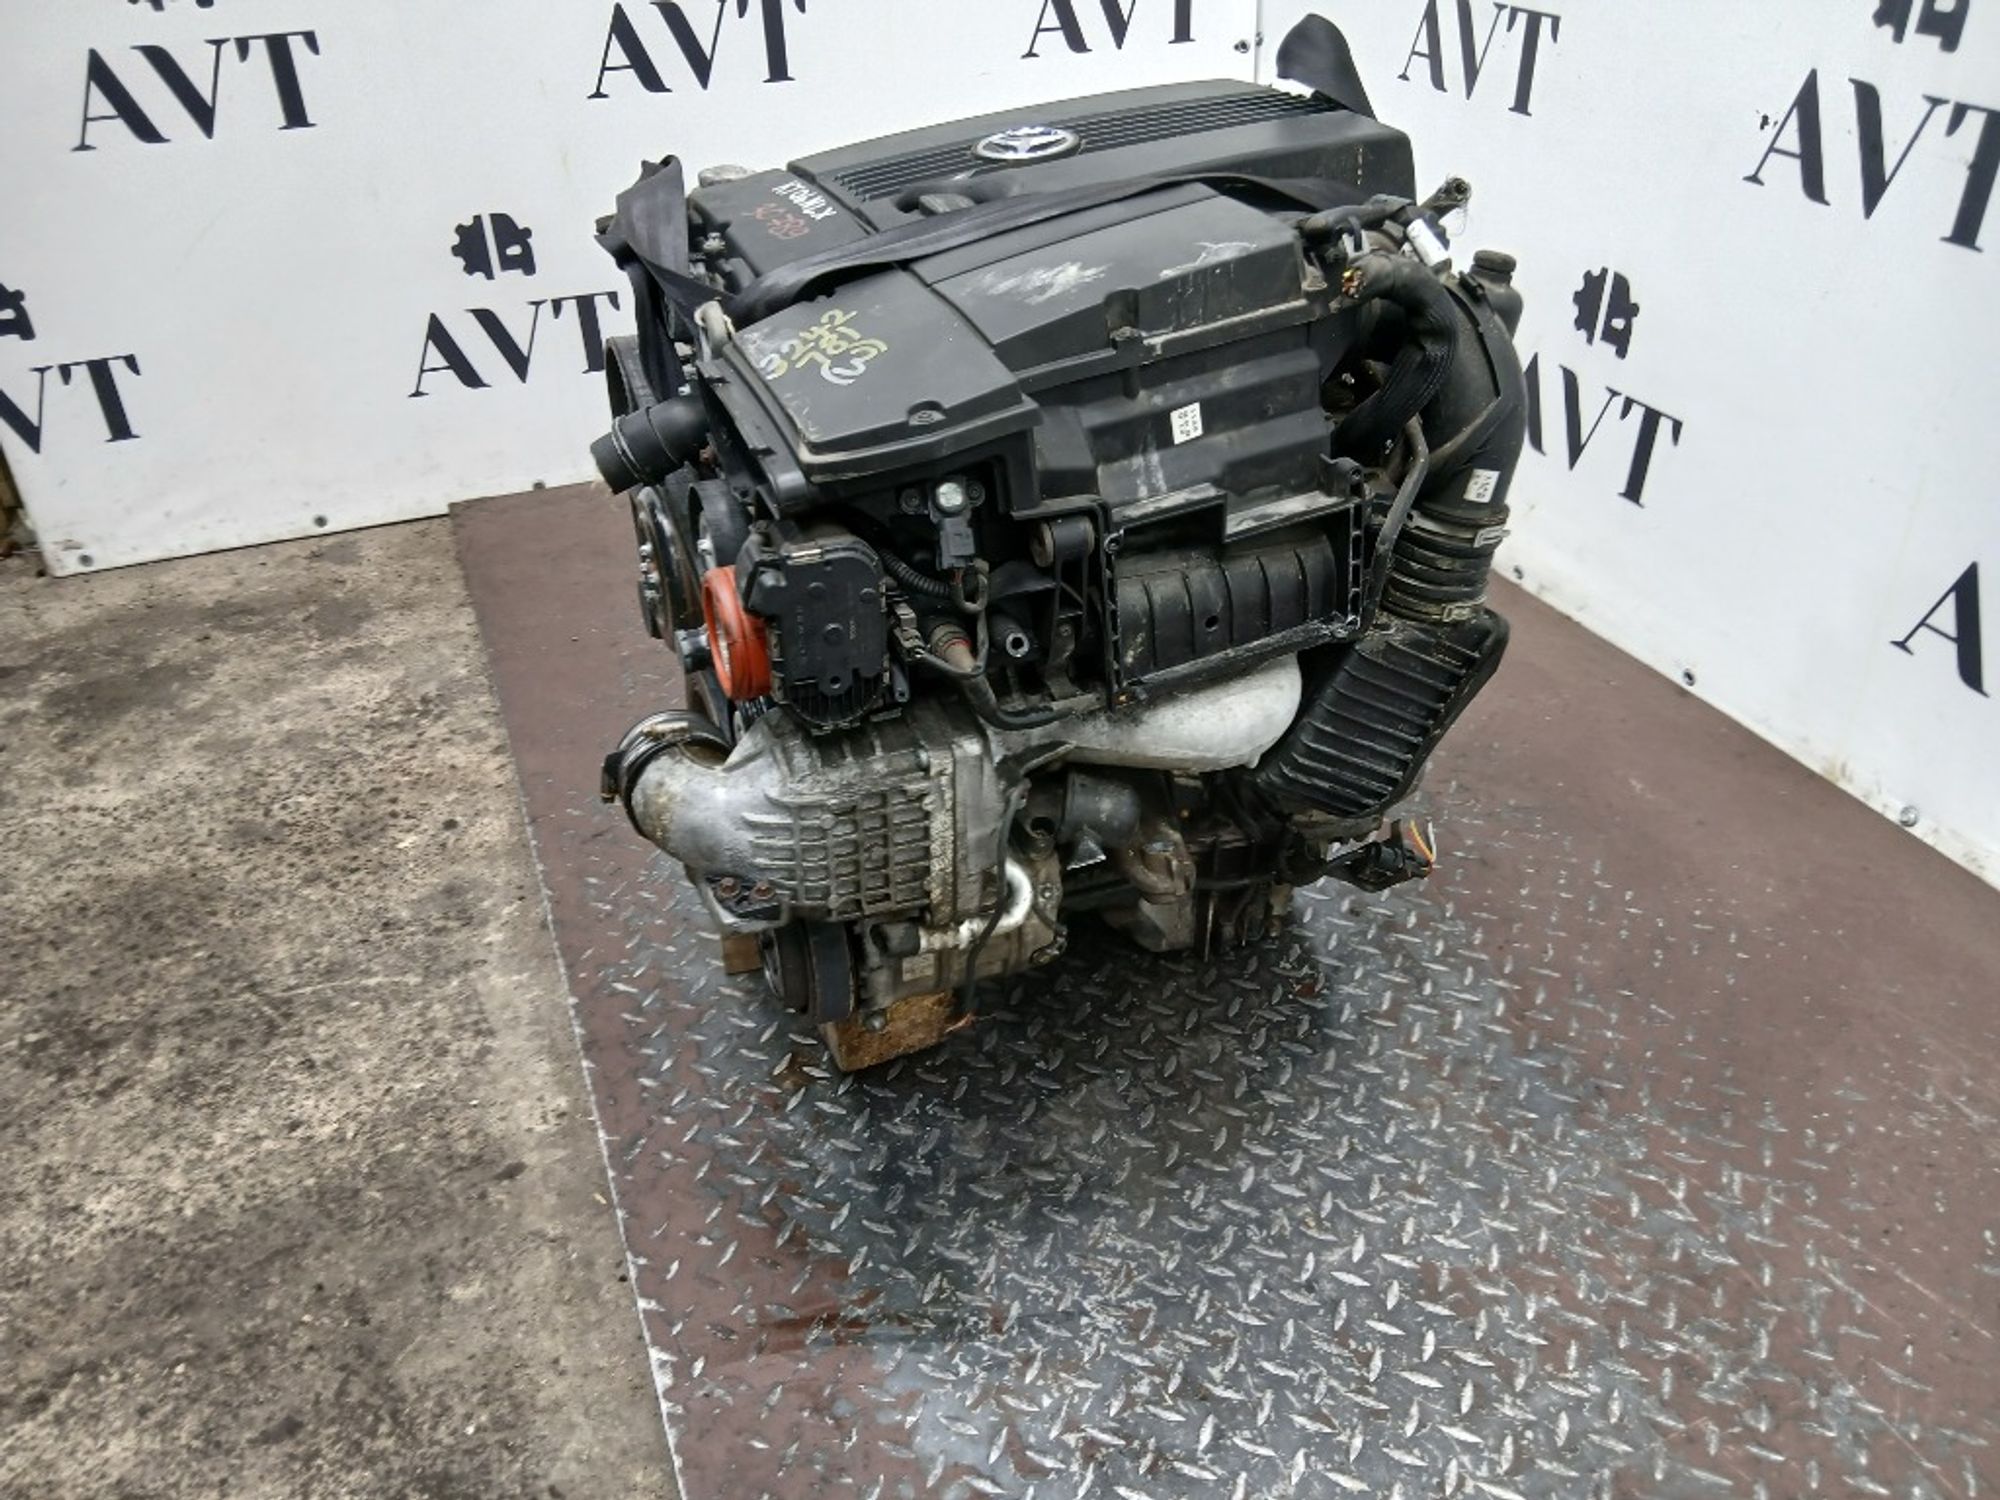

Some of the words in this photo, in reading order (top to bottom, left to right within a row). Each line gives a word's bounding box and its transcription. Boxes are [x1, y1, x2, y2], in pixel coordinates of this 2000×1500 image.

[71, 30, 319, 151] AVT
[588, 0, 806, 99] AVT
[1397, 0, 1561, 117] AVT
[1742, 68, 2000, 253] AVT
[408, 291, 620, 397] AVT
